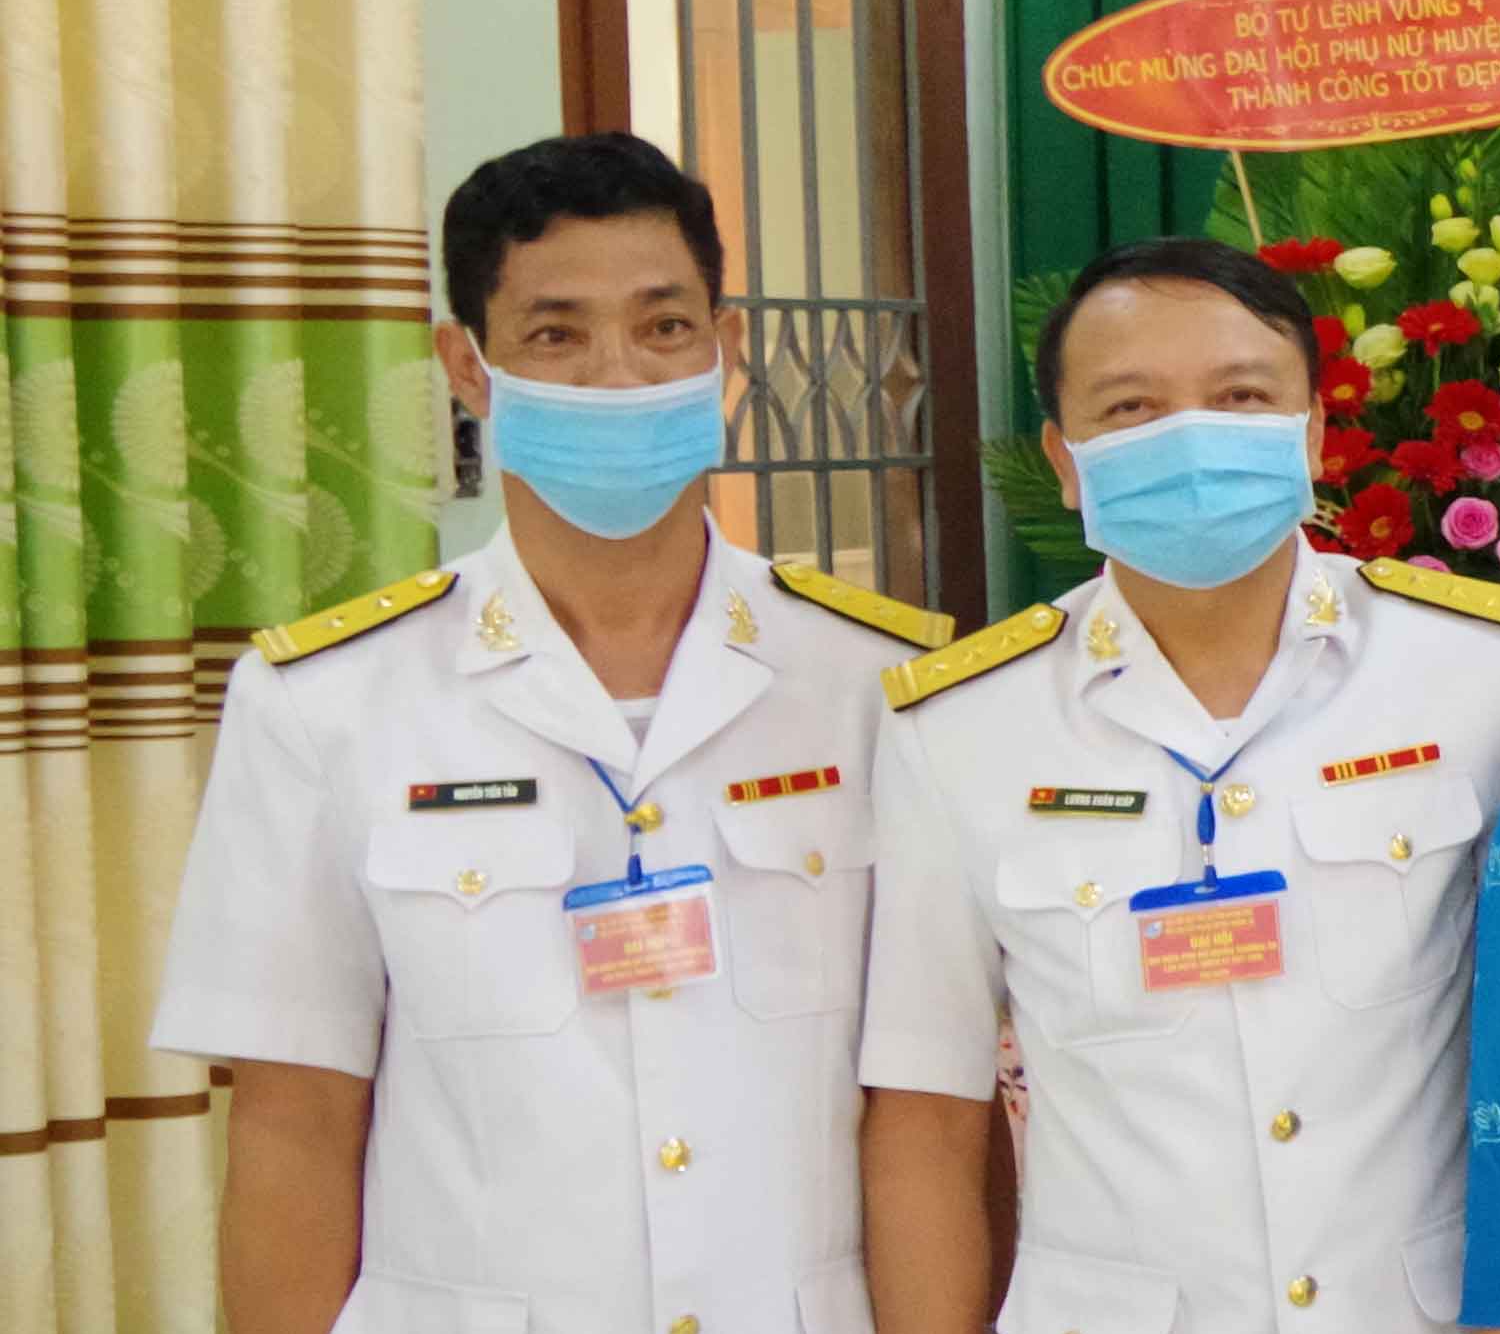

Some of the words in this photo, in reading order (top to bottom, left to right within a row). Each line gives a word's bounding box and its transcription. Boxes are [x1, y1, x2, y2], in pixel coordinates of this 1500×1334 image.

[1234, 1, 1269, 39] BỘ
[1276, 4, 1310, 33] TƯ
[1062, 53, 1134, 91] CHÚC
[1140, 48, 1218, 82] MỪNG
[1224, 49, 1268, 78] ĐẠI
[1276, 36, 1321, 72] HỘI
[1329, 36, 1379, 65] PHỤ
[1387, 26, 1425, 58] NỮ
[1226, 73, 1312, 111] THÀNH
[1318, 68, 1389, 103] CÔNG
[1398, 59, 1447, 93] TỐT
